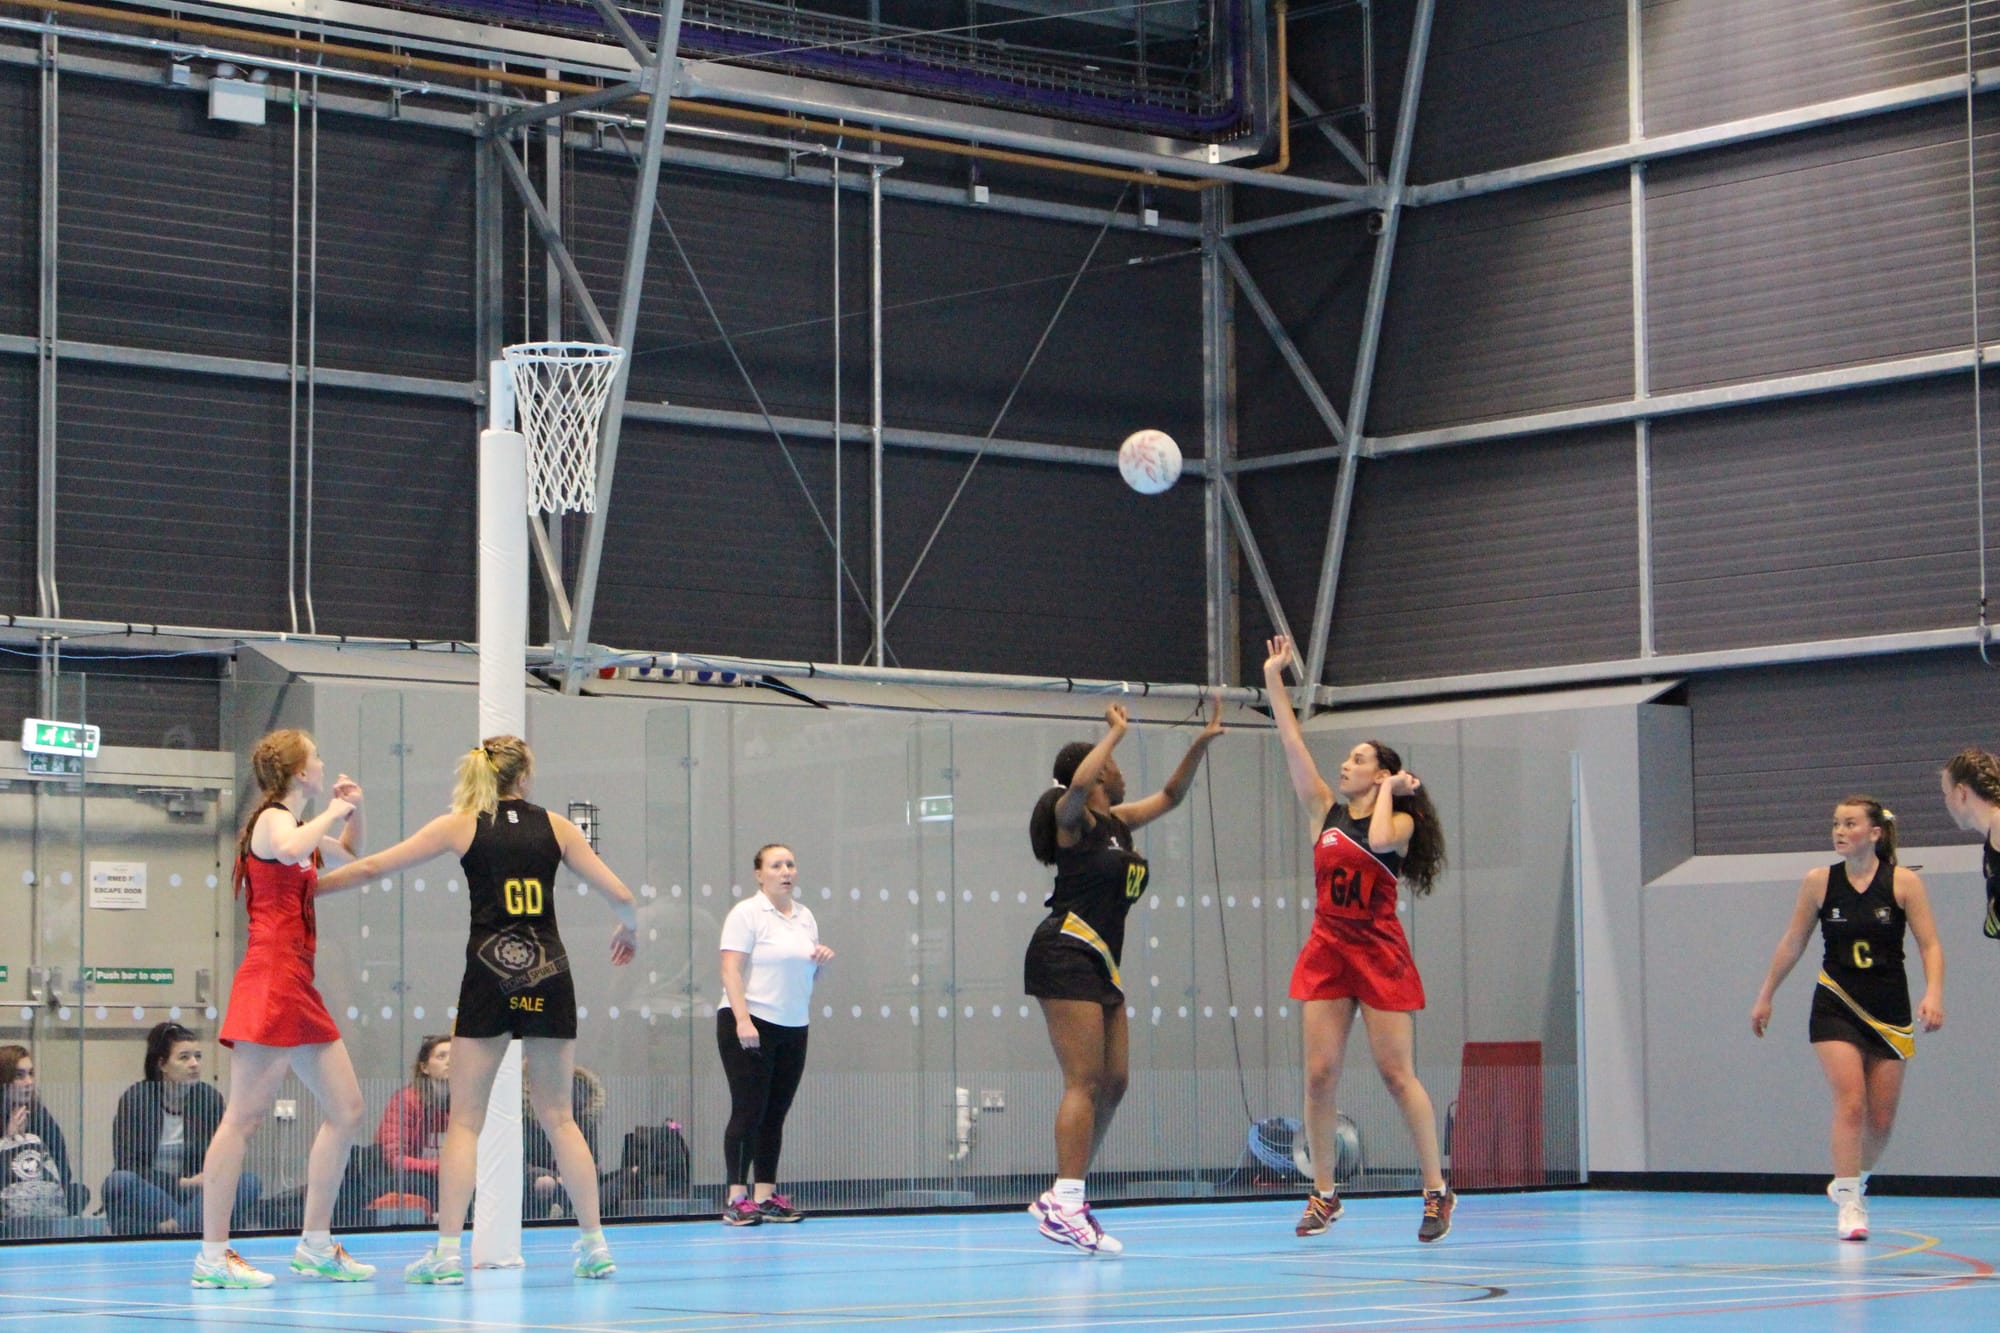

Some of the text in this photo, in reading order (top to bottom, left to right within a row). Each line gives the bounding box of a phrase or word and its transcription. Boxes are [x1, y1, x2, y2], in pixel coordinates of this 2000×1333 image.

[503, 878, 545, 916] GD
[1330, 867, 1366, 909] GA
[1853, 941, 1873, 969] C
[96, 971, 173, 982] Push bar to open
[530, 963, 556, 980] SPORT
[509, 996, 545, 1012] SALE
